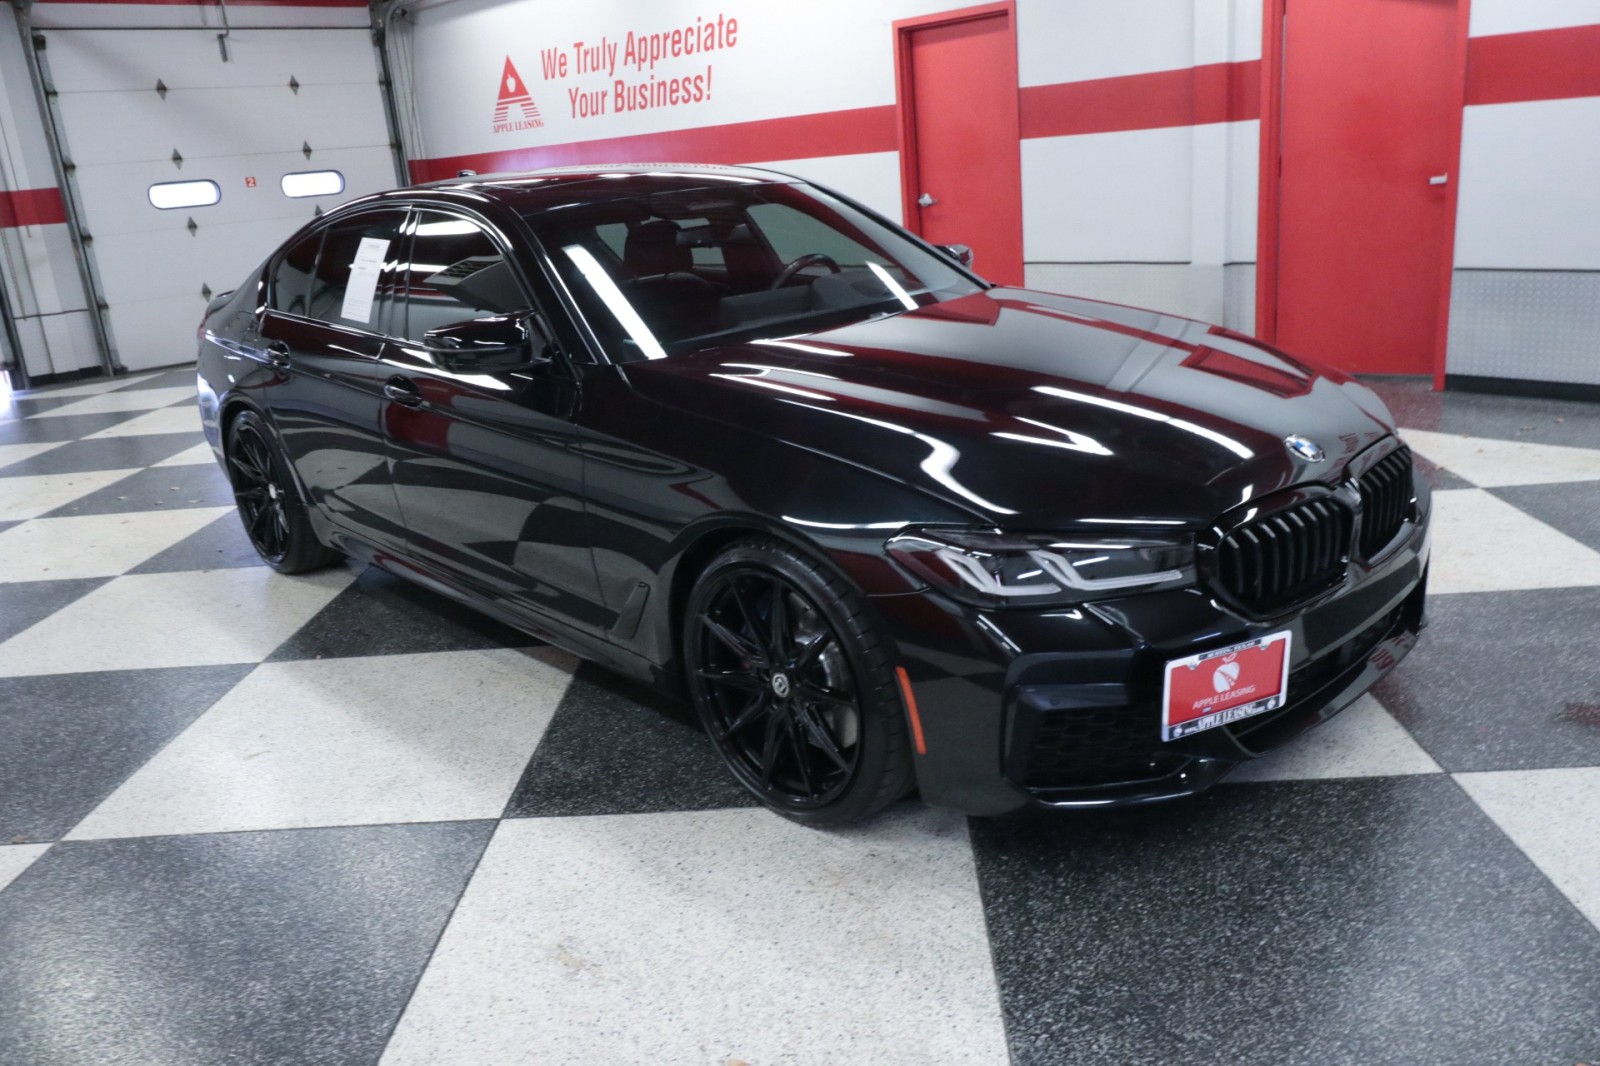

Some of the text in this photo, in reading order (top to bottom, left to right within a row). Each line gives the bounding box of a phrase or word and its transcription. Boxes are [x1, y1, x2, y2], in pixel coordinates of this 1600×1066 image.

[541, 14, 738, 80] We Truly Appreciate
[568, 65, 712, 119] Your Business!
[493, 122, 513, 133] APPLE
[1192, 685, 1256, 709] APPLE LEASING
